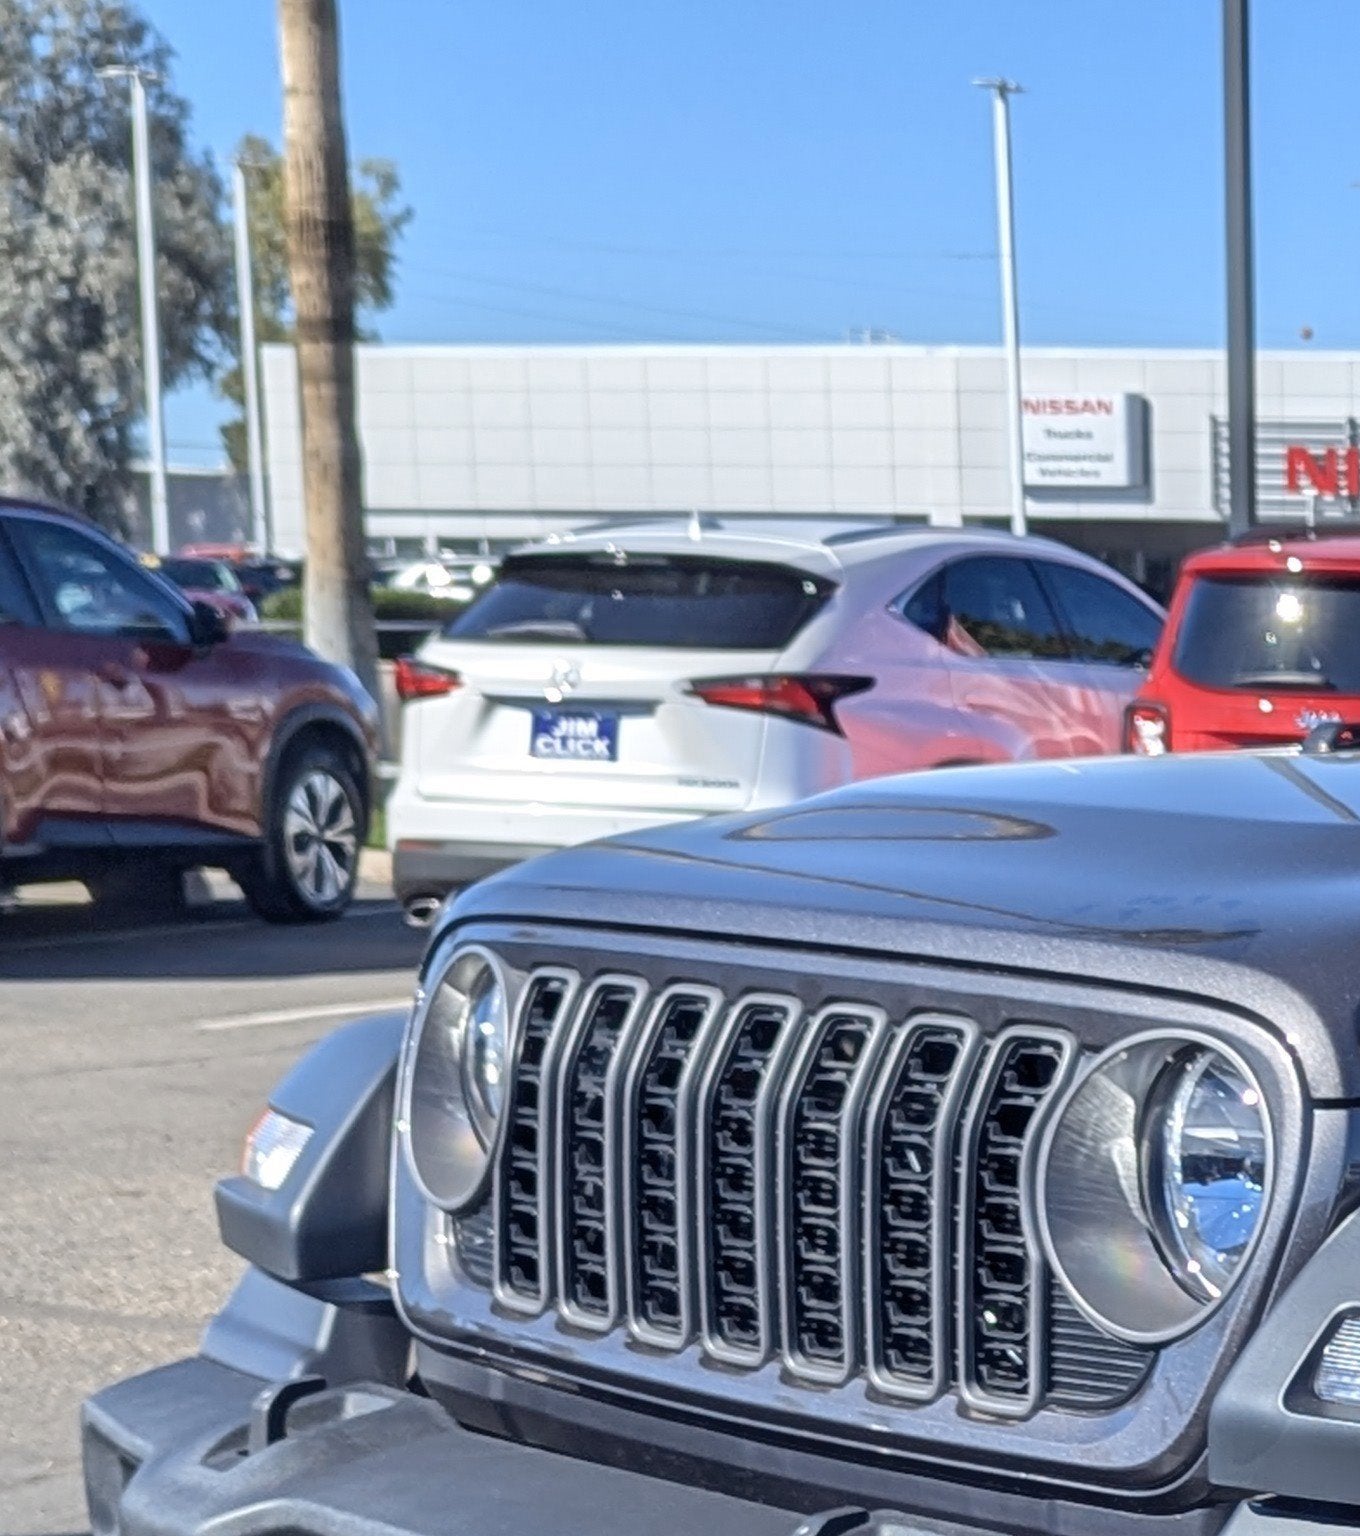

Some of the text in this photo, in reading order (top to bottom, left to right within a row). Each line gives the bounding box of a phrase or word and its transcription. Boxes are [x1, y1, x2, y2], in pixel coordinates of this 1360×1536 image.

[1022, 398, 1113, 416] NISSAN
[551, 716, 598, 737] JIM
[536, 734, 610, 757] CLICK
